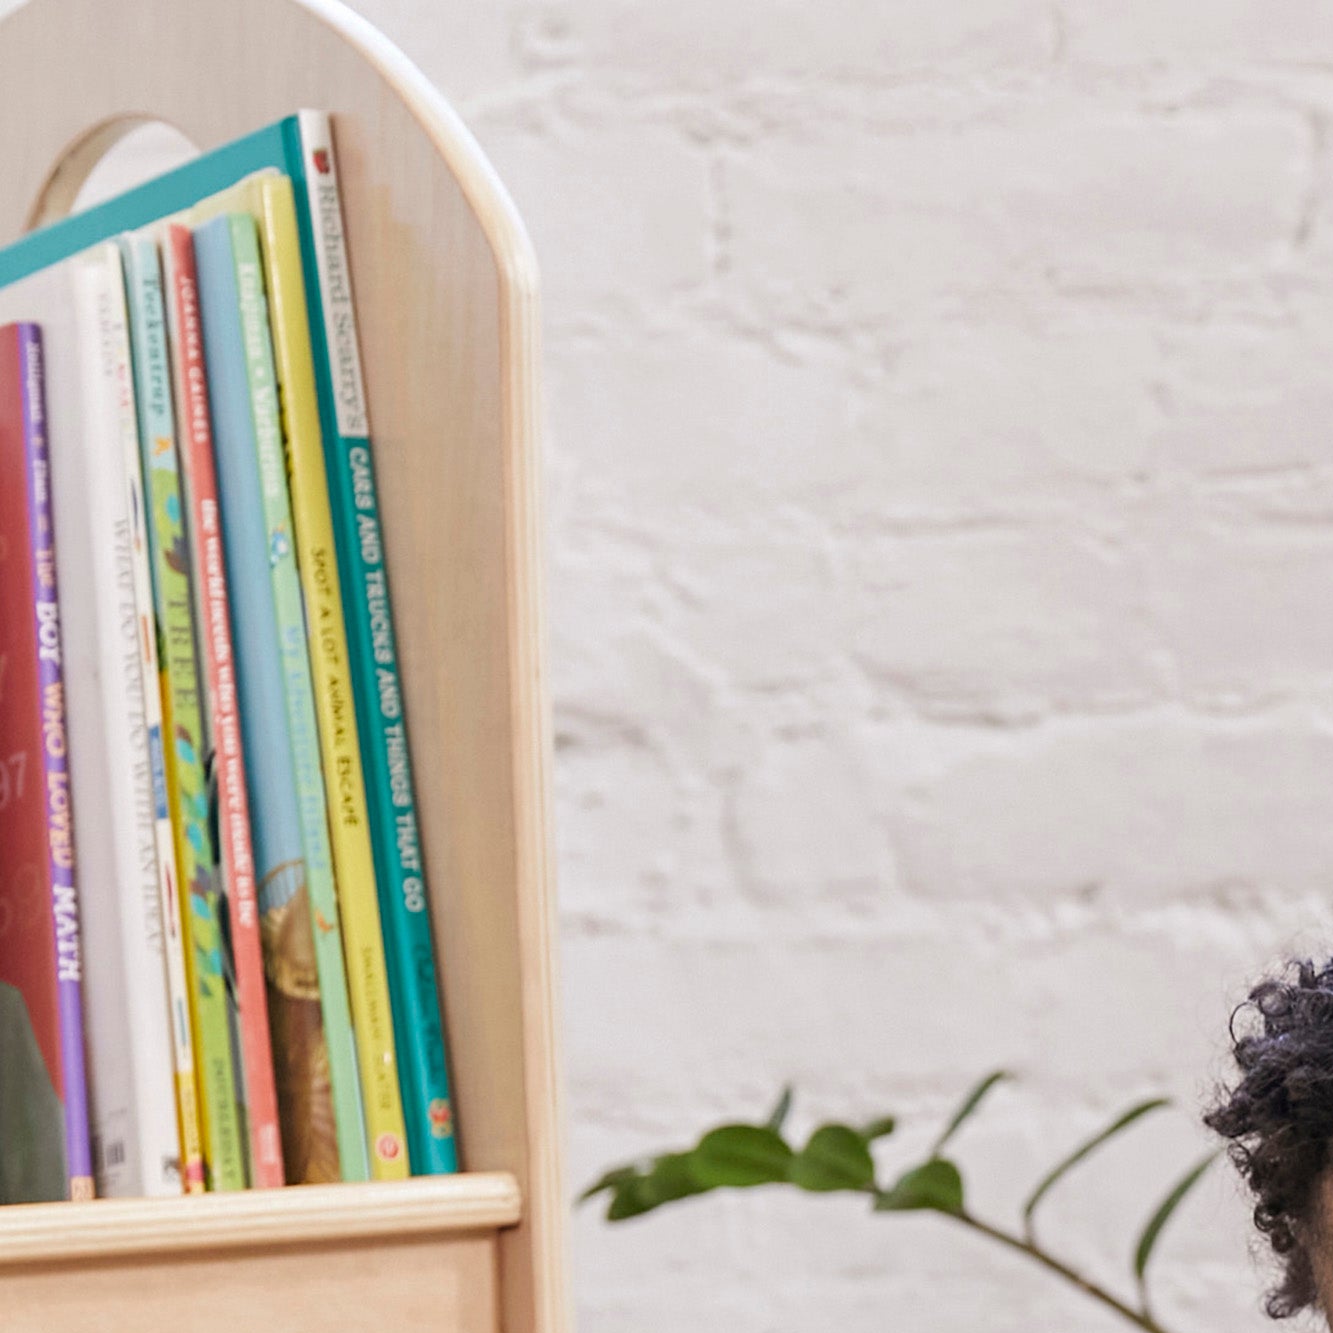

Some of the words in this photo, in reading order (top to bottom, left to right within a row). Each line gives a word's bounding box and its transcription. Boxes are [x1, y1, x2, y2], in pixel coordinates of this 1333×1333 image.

[316, 183, 351, 302] Richard
[138, 275, 172, 417] Teckentrup
[178, 275, 200, 360] JOANNA
[330, 312, 366, 429] Scarry's
[187, 366, 208, 443] GAINES
[347, 446, 375, 509] CARS
[199, 499, 219, 533] the
[356, 514, 382, 563] AND
[110, 518, 133, 588] WHAT
[203, 537, 225, 597] world
[310, 548, 332, 595] SPOT
[35, 601, 60, 664] BOY
[117, 601, 137, 642] DO
[209, 600, 231, 661] needs
[317, 606, 333, 619] A
[363, 570, 394, 664] TRUCKS
[166, 600, 198, 708] TREE
[319, 627, 339, 664] LOT
[122, 651, 143, 706] YOU
[215, 666, 236, 711] who
[375, 668, 401, 718] AND
[40, 680, 66, 759] WHO
[127, 711, 147, 754] DO
[214, 715, 236, 752] you
[325, 676, 350, 746] ANIMAL
[335, 755, 359, 826] ESCAPE
[382, 723, 412, 807] THINGS
[45, 770, 73, 868] LOVED
[130, 761, 154, 837] WITH
[229, 813, 250, 872] made
[393, 813, 420, 871] THAT
[238, 901, 256, 927] be
[401, 877, 425, 912] GO
[51, 884, 81, 981] MATH
